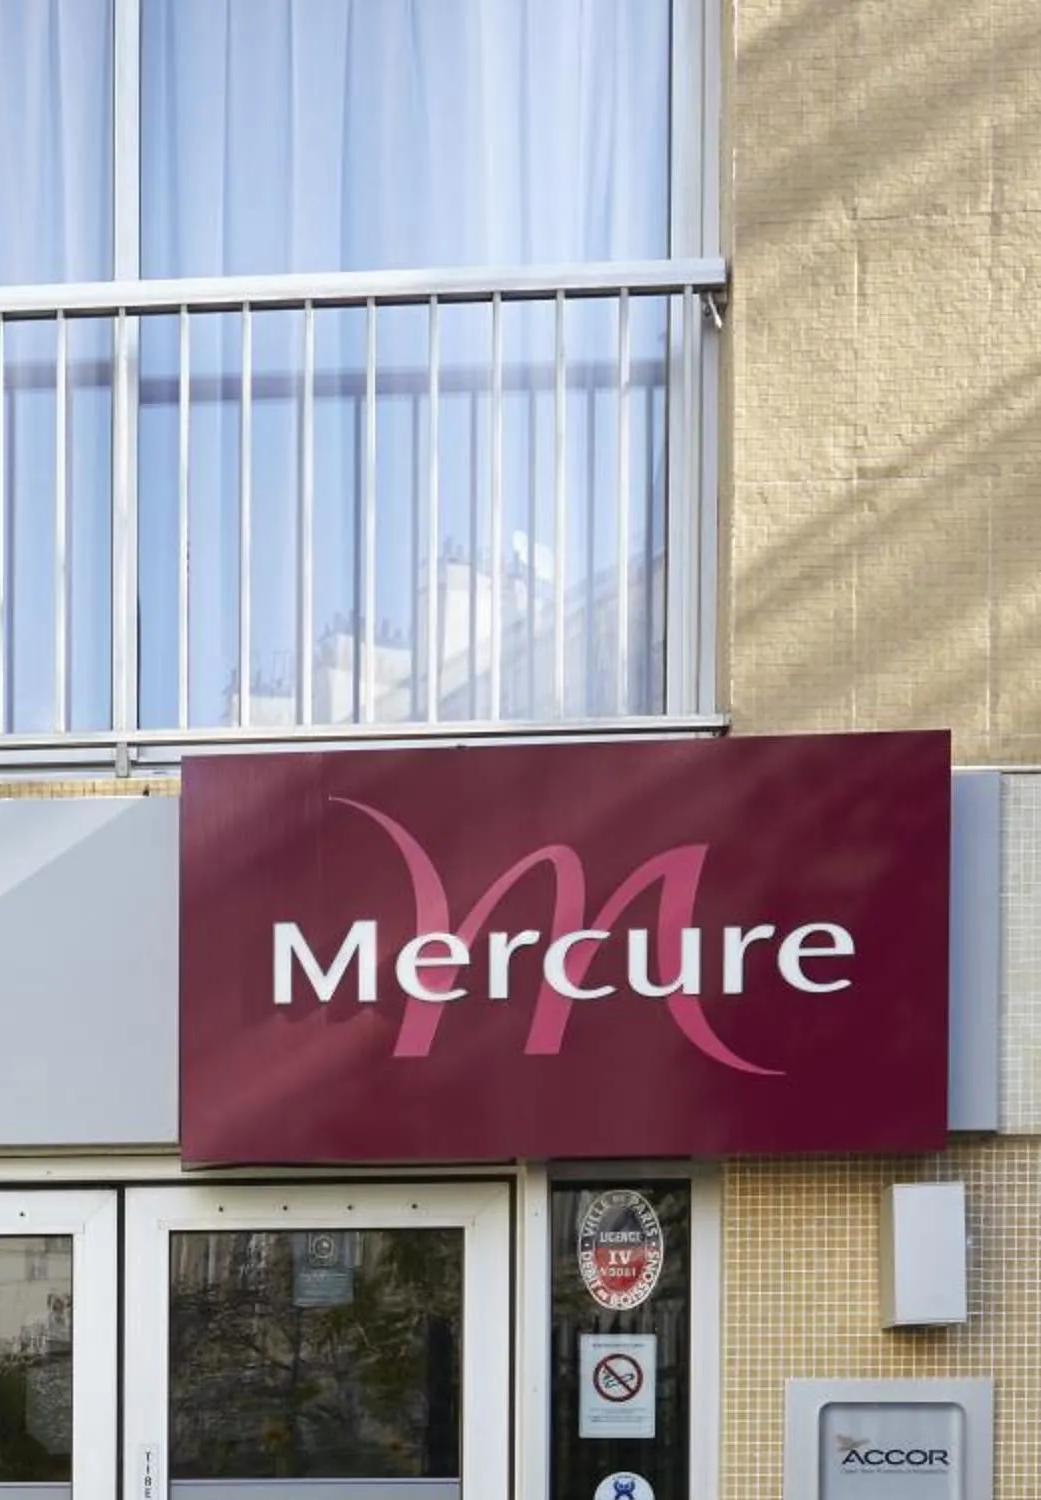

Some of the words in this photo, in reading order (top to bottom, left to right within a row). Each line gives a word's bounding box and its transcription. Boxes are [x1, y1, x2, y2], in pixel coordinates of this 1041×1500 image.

[272, 919, 857, 1005] Mercure
[583, 1198, 610, 1238] VILLE
[629, 1194, 659, 1238] PARIS
[599, 1230, 643, 1243] LICENCE
[608, 1248, 633, 1265] IV
[841, 1448, 950, 1466] ACCOR
